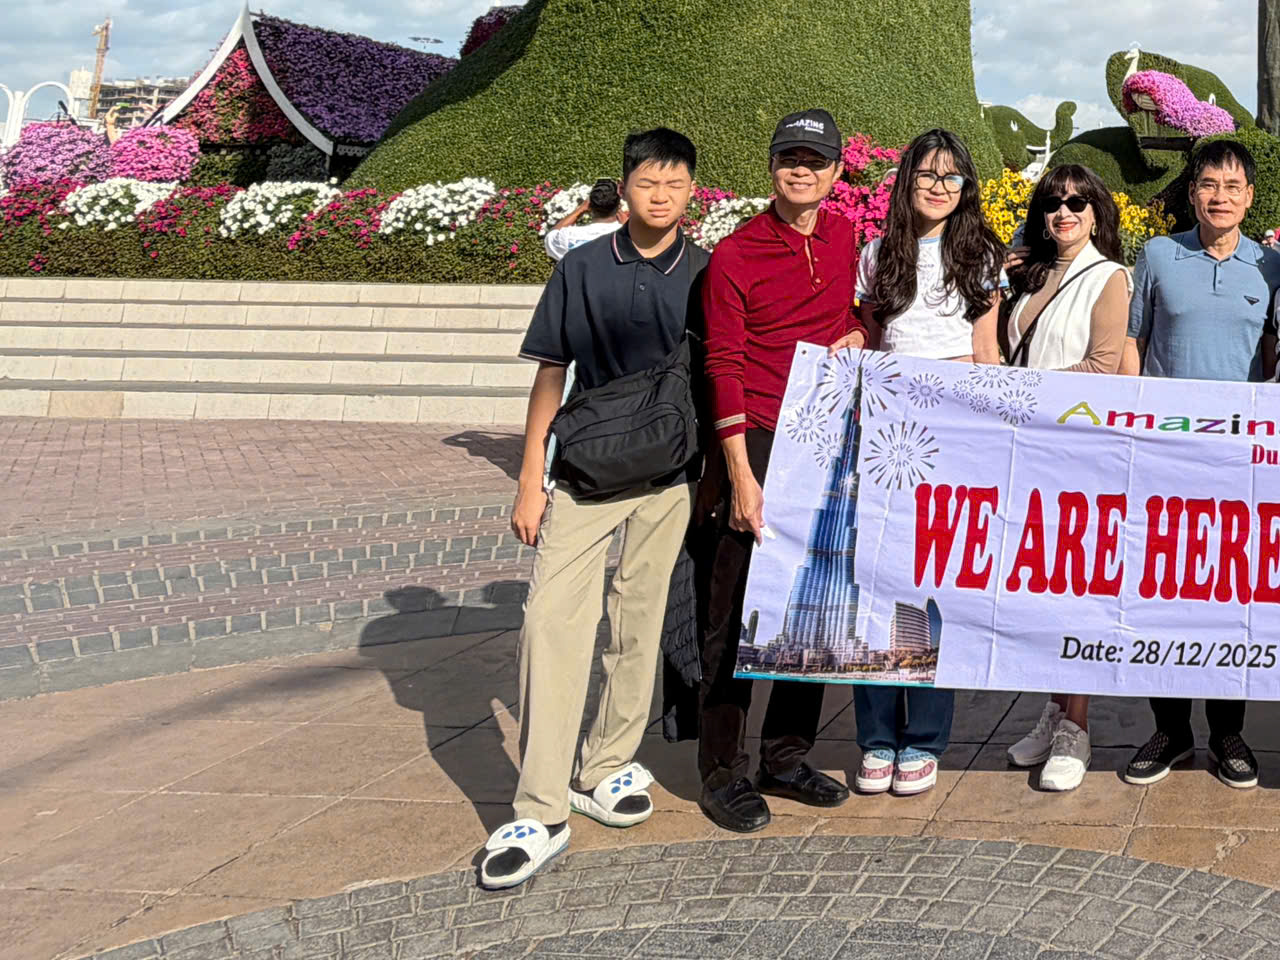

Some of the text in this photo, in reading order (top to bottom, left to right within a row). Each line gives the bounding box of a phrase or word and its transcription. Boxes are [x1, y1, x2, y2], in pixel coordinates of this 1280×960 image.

[914, 483, 999, 591] WE
[1005, 488, 1128, 598] ARE
[1060, 636, 1124, 664] Date:
[1129, 639, 1278, 669] 28/12/2025
